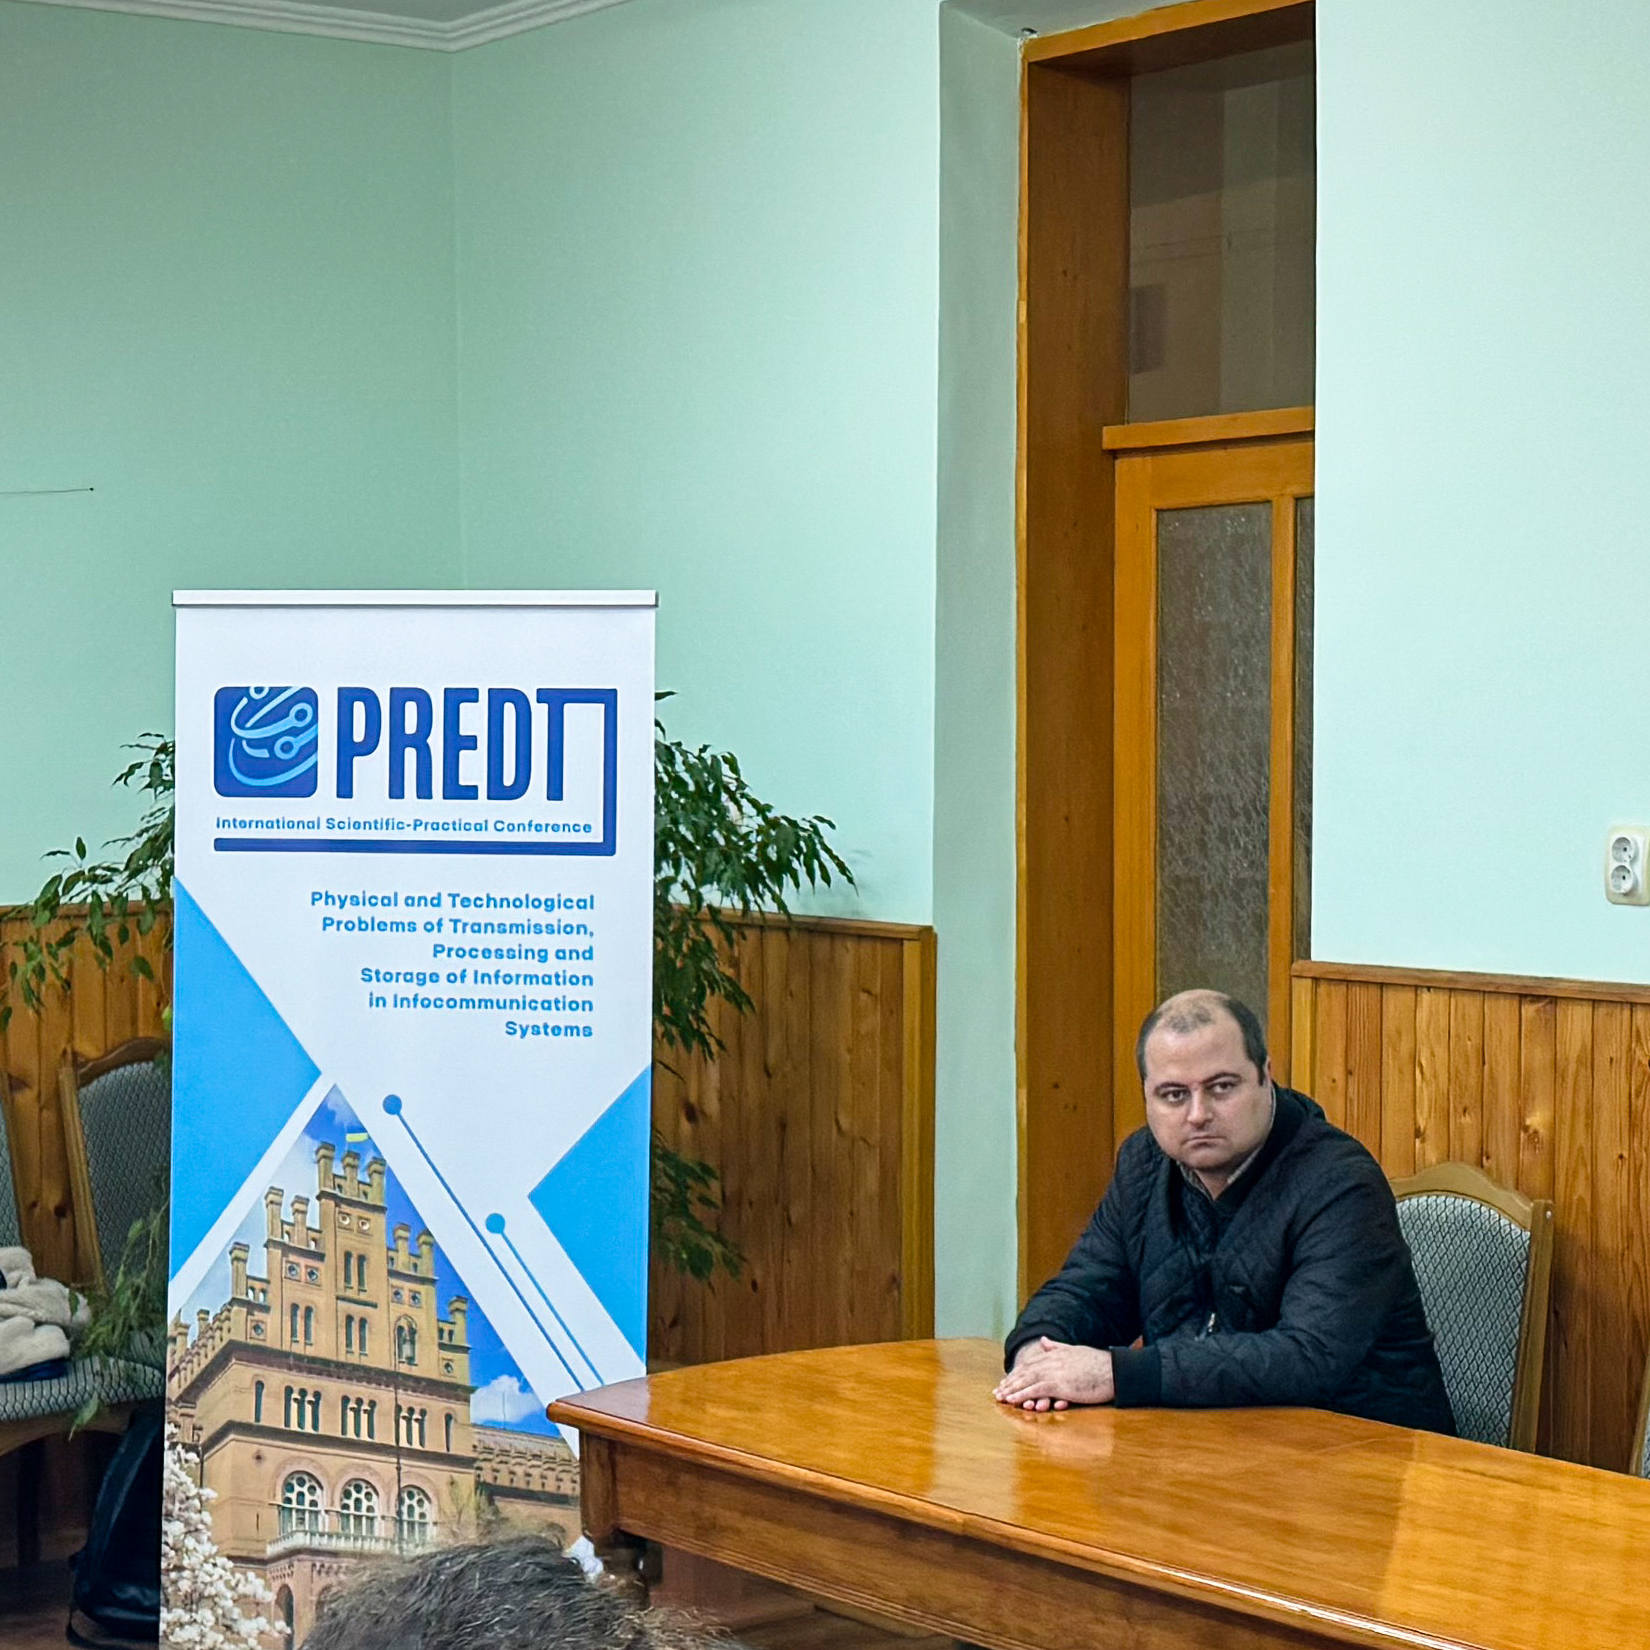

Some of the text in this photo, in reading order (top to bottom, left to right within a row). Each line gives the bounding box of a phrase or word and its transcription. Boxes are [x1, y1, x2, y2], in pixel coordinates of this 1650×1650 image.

[336, 687, 572, 801] PREDT
[216, 816, 592, 833] International Scientific-Practical Conference
[311, 890, 595, 913] Physical and Technological
[322, 916, 594, 939] Problems of Transmission,
[433, 943, 594, 964] Processing and
[360, 967, 594, 987] Storage of Information
[369, 991, 594, 1013] in Infocommunication
[505, 1021, 593, 1040] Systems
